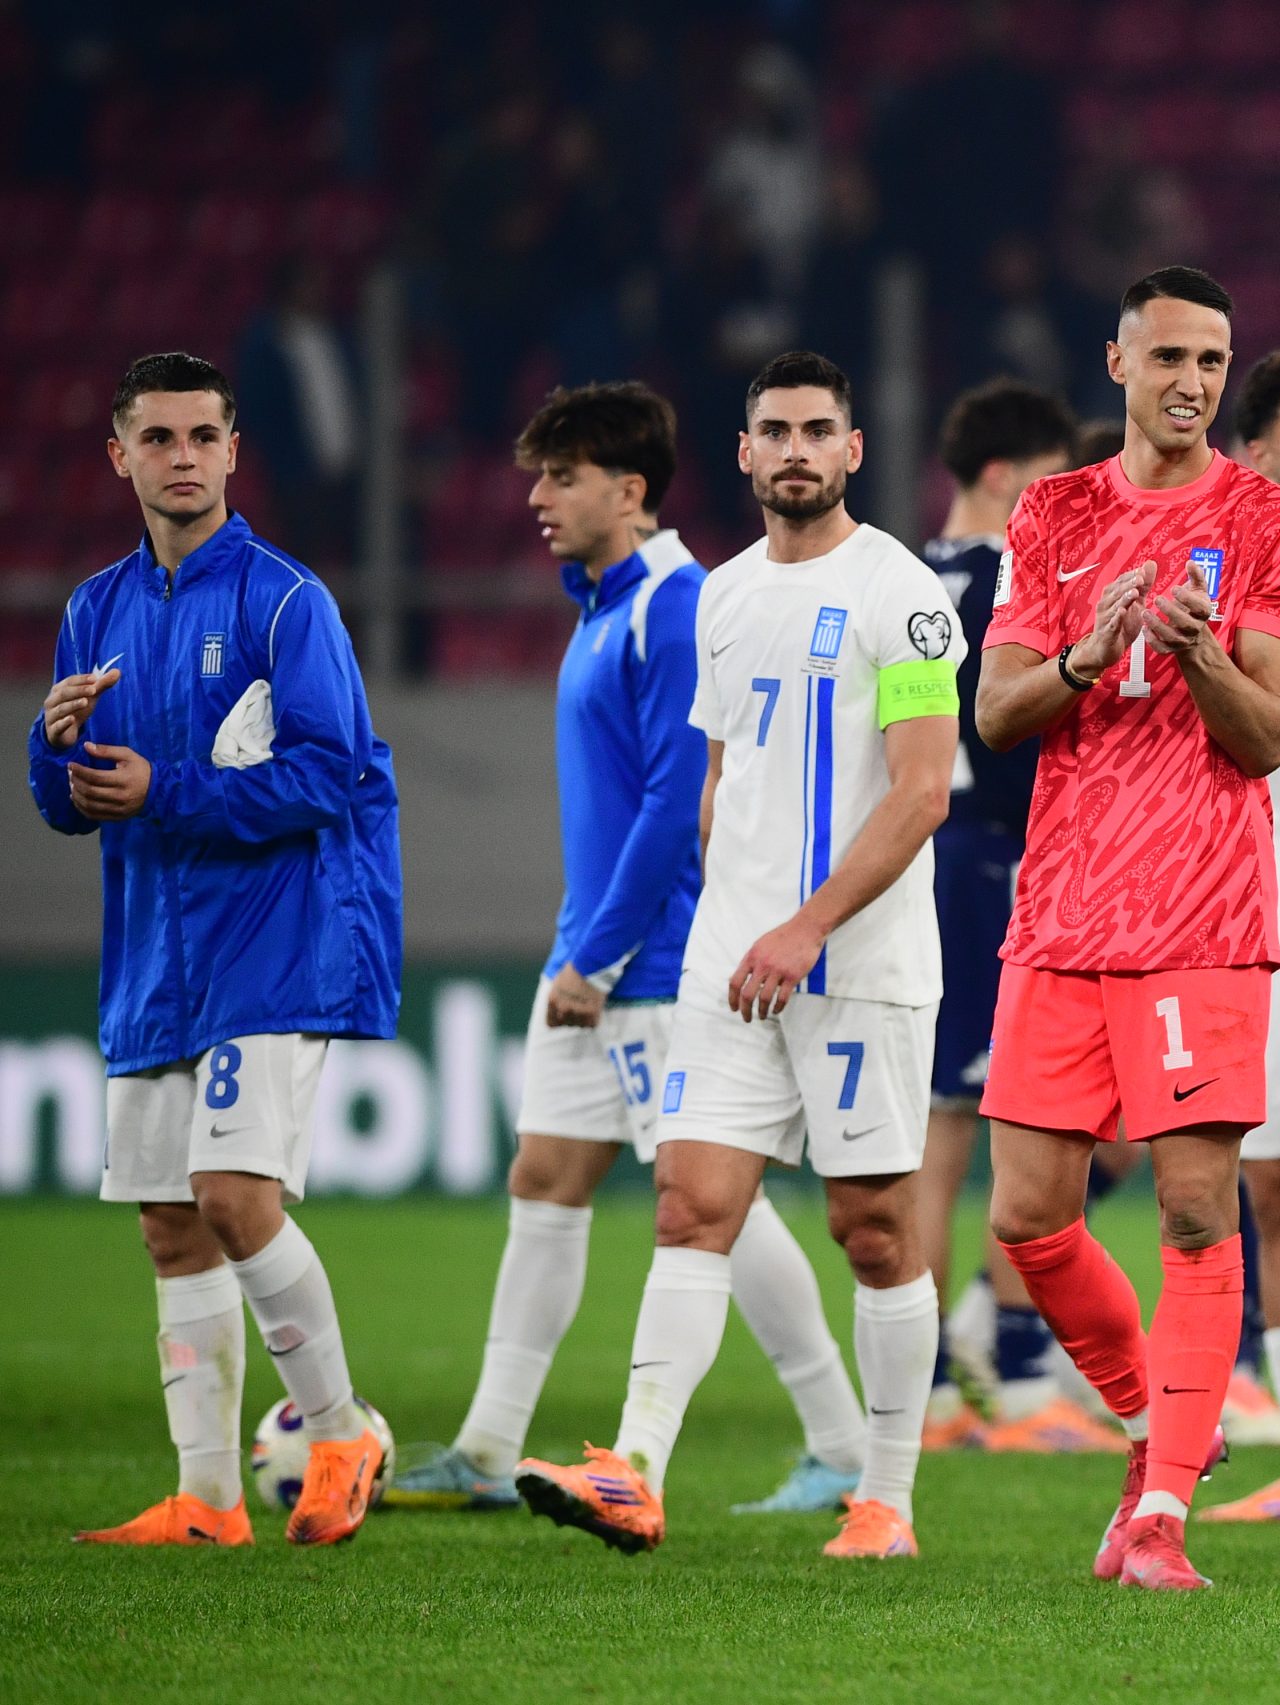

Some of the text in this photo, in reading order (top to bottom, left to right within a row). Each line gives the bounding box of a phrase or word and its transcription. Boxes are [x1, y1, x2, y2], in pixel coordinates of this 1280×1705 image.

[1120, 627, 1150, 697] 1
[752, 679, 781, 746] 7
[1155, 996, 1193, 1070] 1
[205, 1043, 242, 1110] 8
[608, 1041, 651, 1106] 15
[827, 1042, 865, 1109] 7
